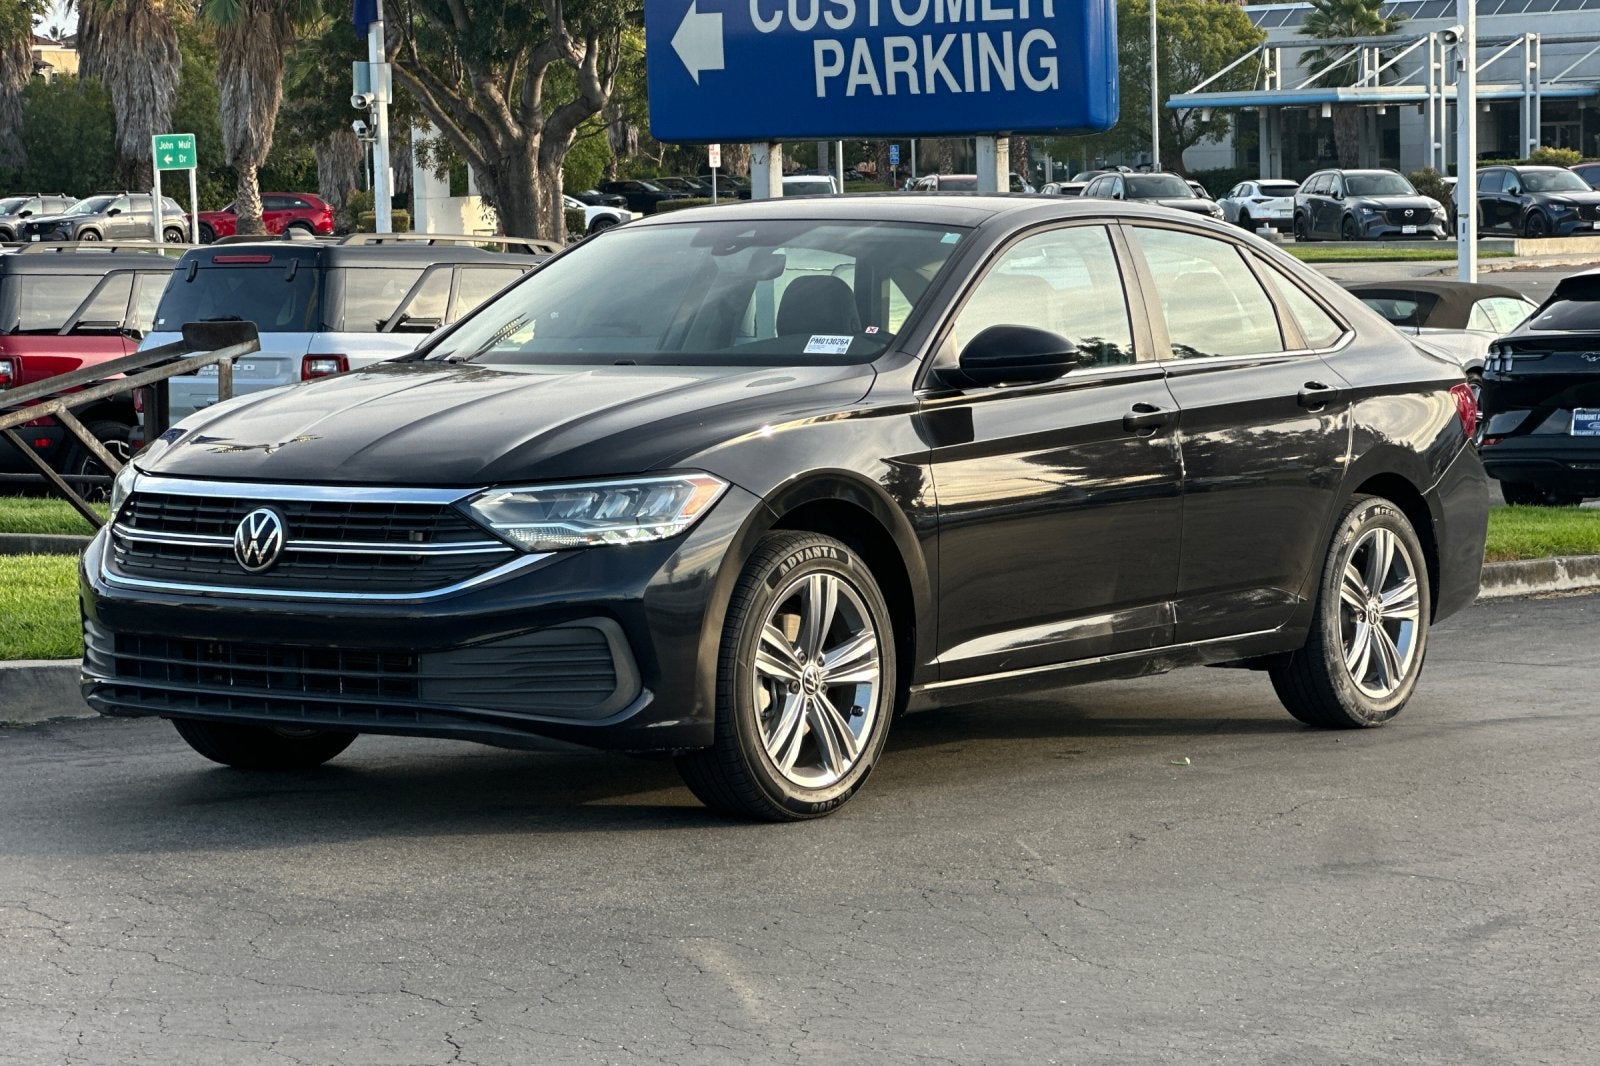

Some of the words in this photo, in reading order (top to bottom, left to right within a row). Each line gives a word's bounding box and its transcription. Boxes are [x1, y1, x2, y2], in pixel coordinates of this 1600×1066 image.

[813, 28, 1059, 97] PARKING
[159, 141, 174, 150] John
[178, 140, 191, 149] Muir
[179, 154, 187, 163] Dr
[236, 509, 282, 570] VW
[780, 546, 838, 576] ADVANTA
